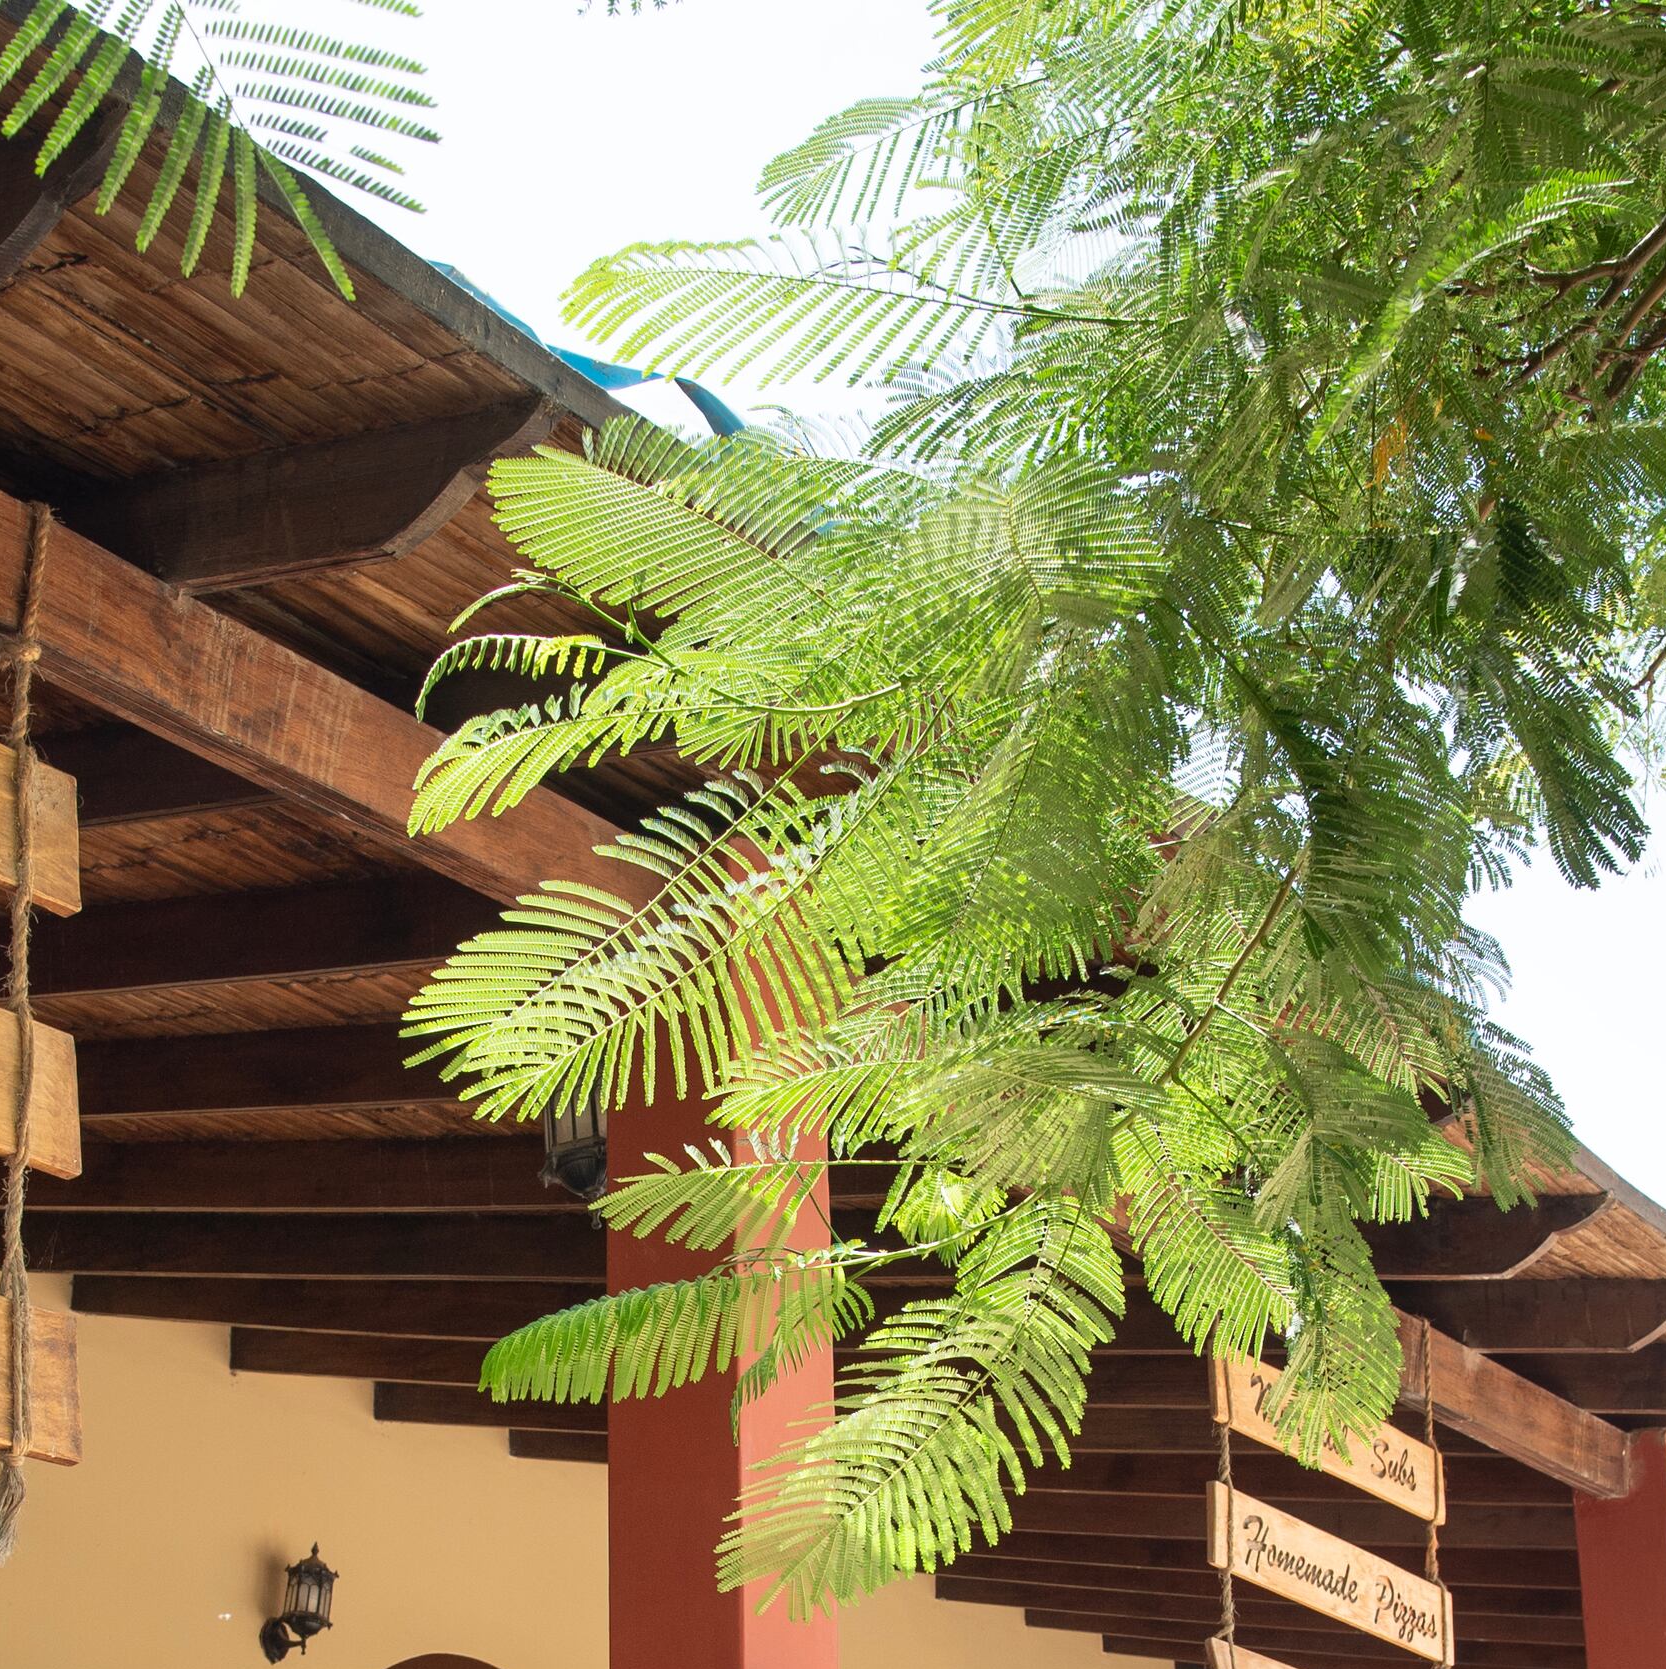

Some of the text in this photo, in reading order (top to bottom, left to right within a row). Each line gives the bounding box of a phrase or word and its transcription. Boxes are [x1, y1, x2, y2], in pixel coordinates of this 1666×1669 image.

[1370, 1438, 1417, 1492] Subs
[1243, 1514, 1438, 1643] Homemade Pizzas
